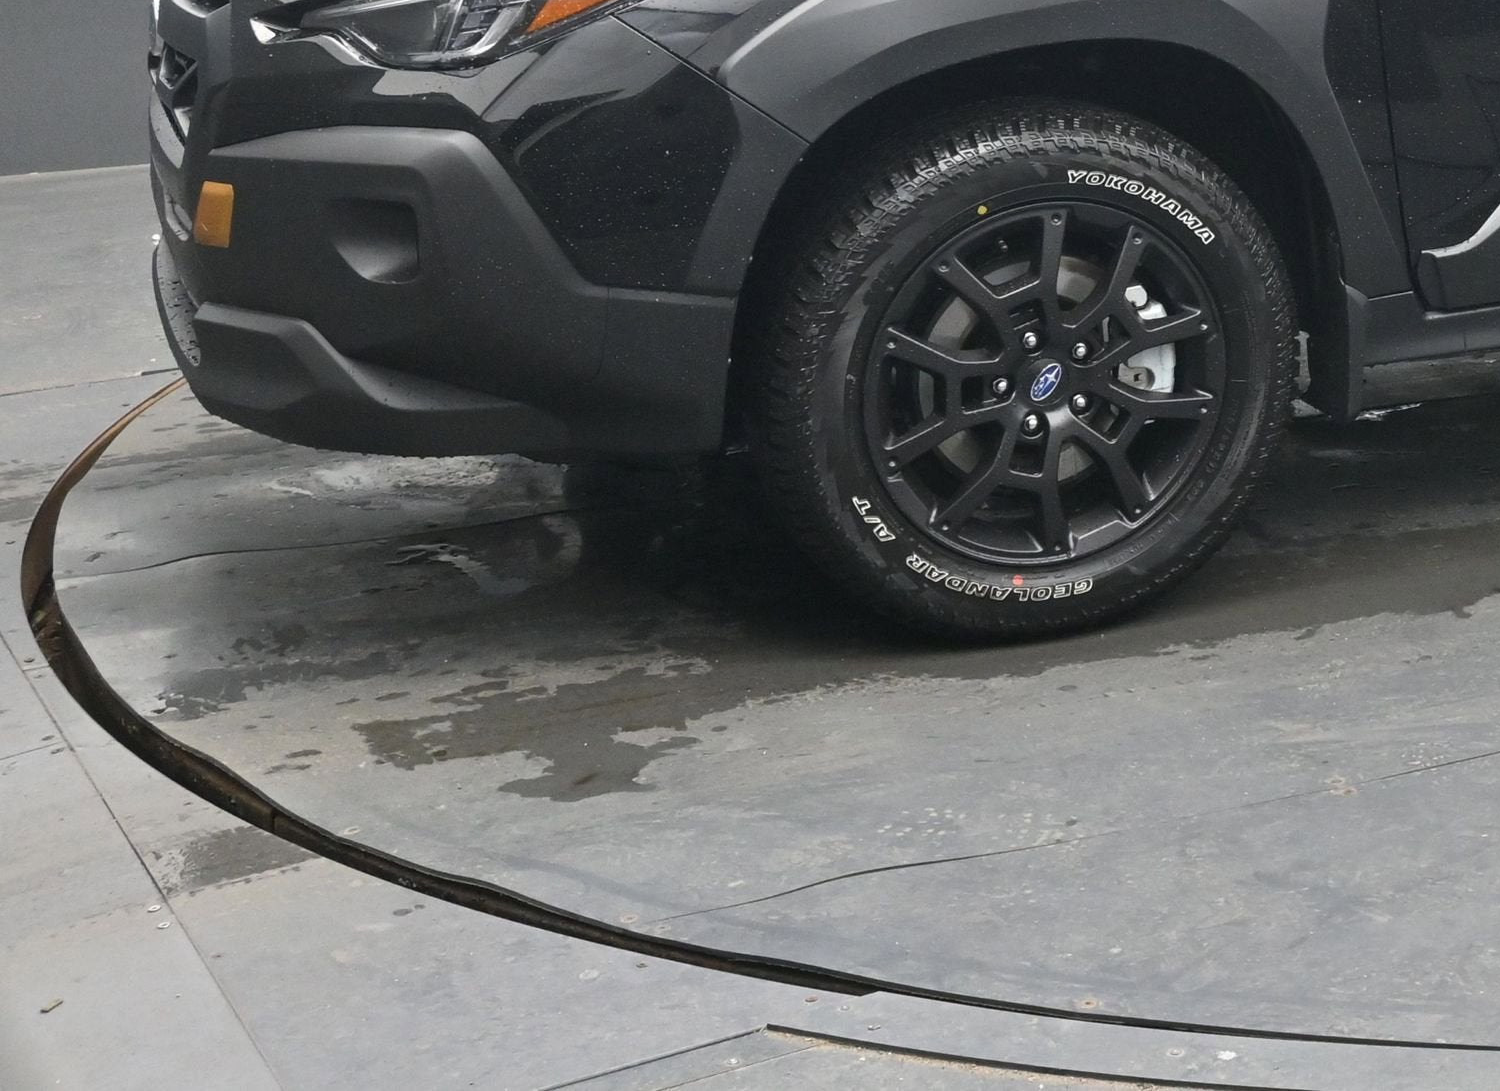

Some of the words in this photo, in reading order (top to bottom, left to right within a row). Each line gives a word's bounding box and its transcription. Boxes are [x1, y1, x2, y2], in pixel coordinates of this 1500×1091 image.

[1067, 169, 1215, 245] YOKOHAMA
[852, 496, 896, 542] A/T
[905, 550, 1094, 602] GEOLANDAR
